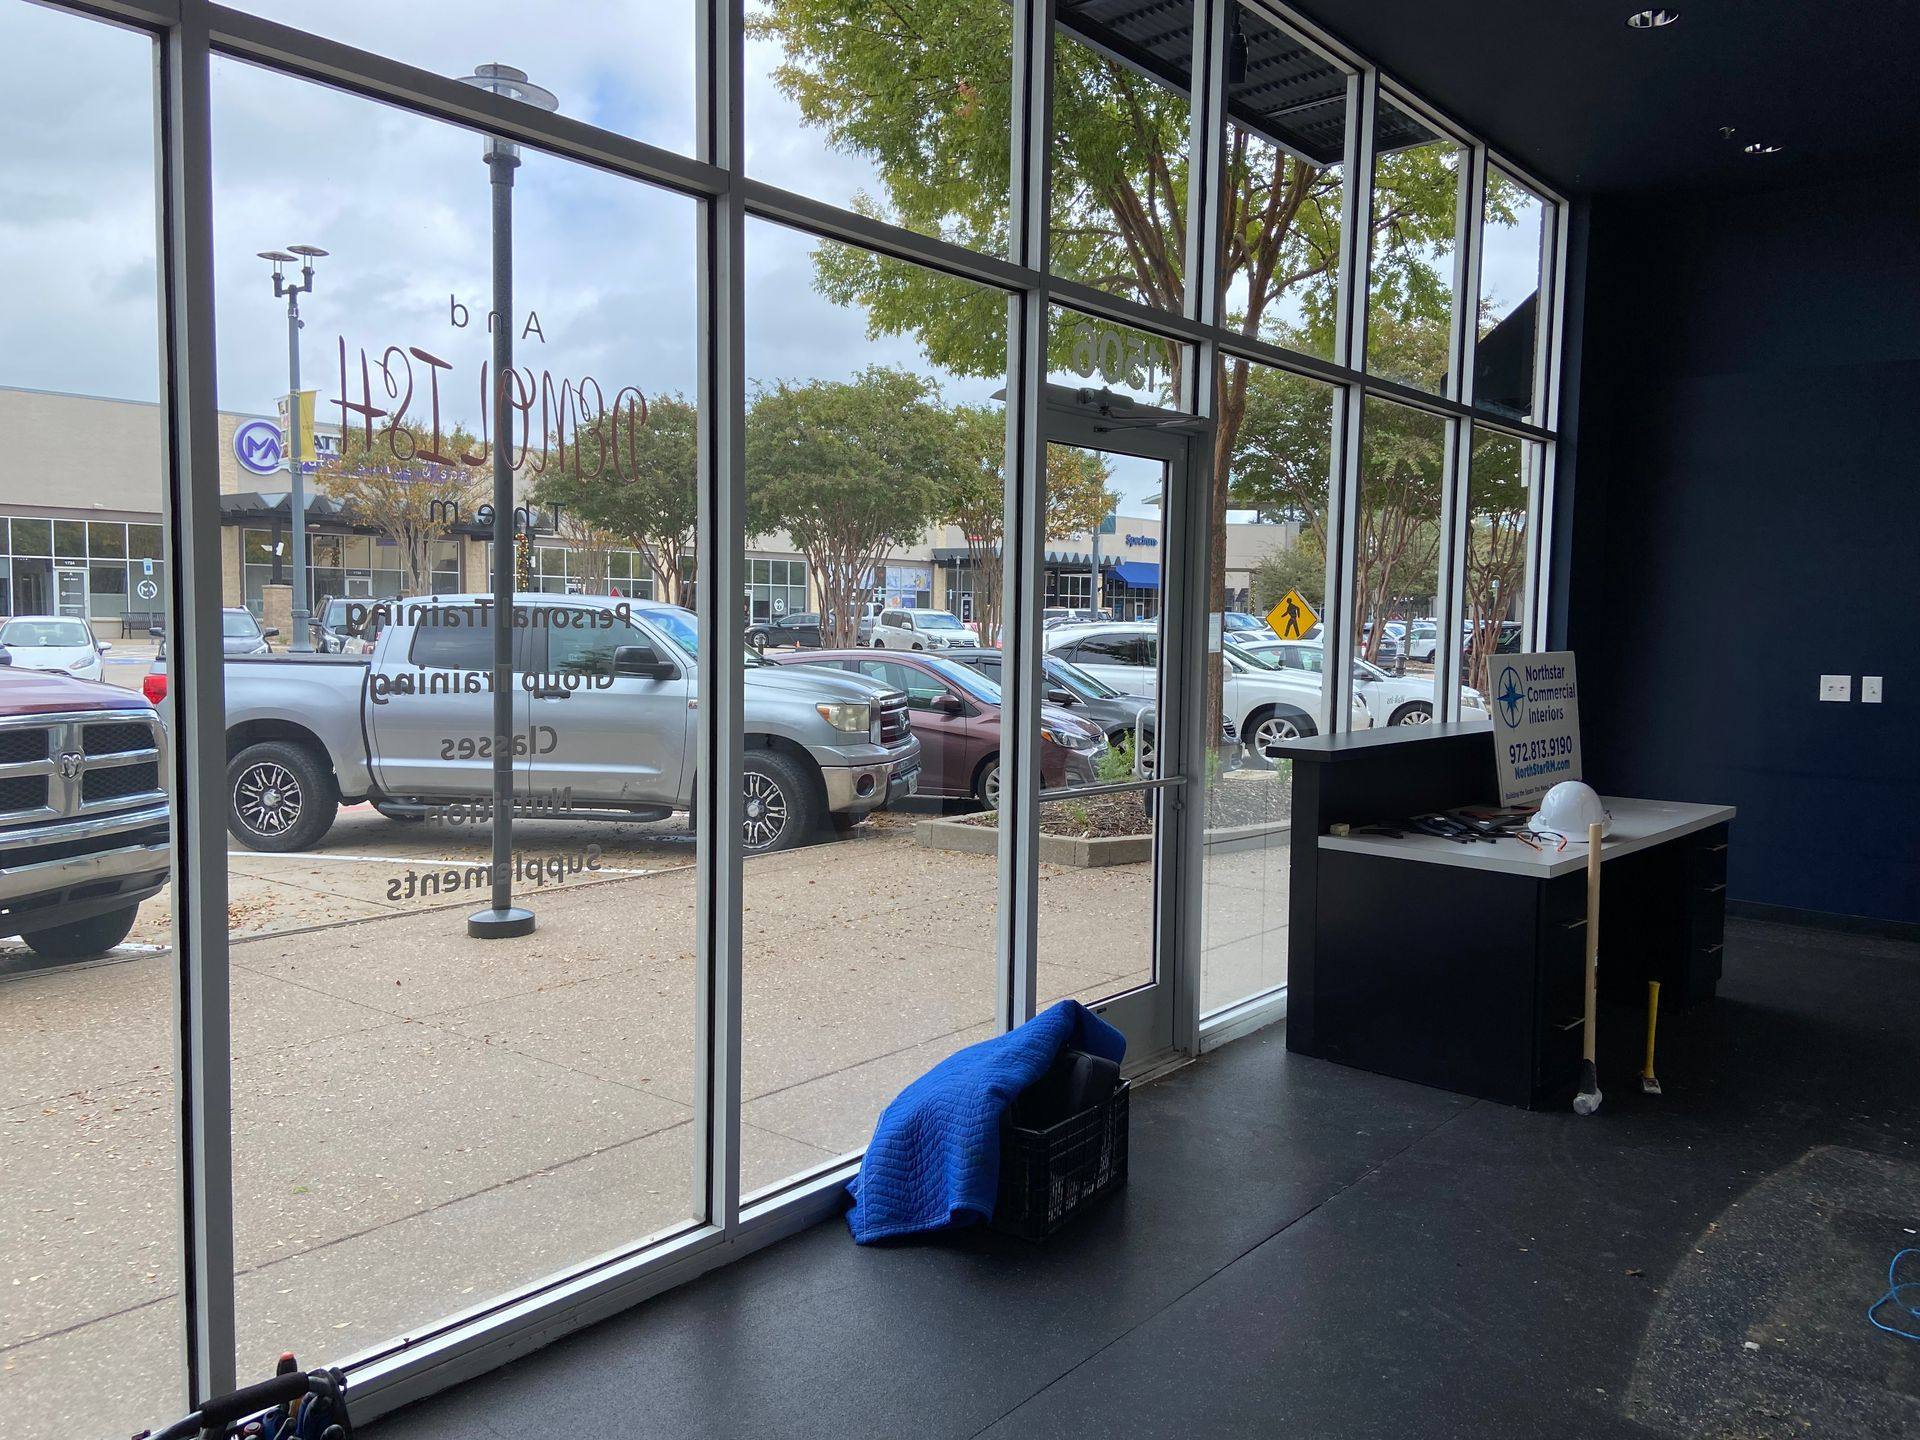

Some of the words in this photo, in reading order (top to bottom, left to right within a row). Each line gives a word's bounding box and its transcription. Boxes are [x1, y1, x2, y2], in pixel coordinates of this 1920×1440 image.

[1525, 664, 1565, 682] Northstar
[1527, 682, 1576, 703] Commercial
[1529, 705, 1564, 724] Interiors
[1509, 735, 1573, 765] 972.813.9190
[1514, 759, 1571, 780] NorthStarRM.com
